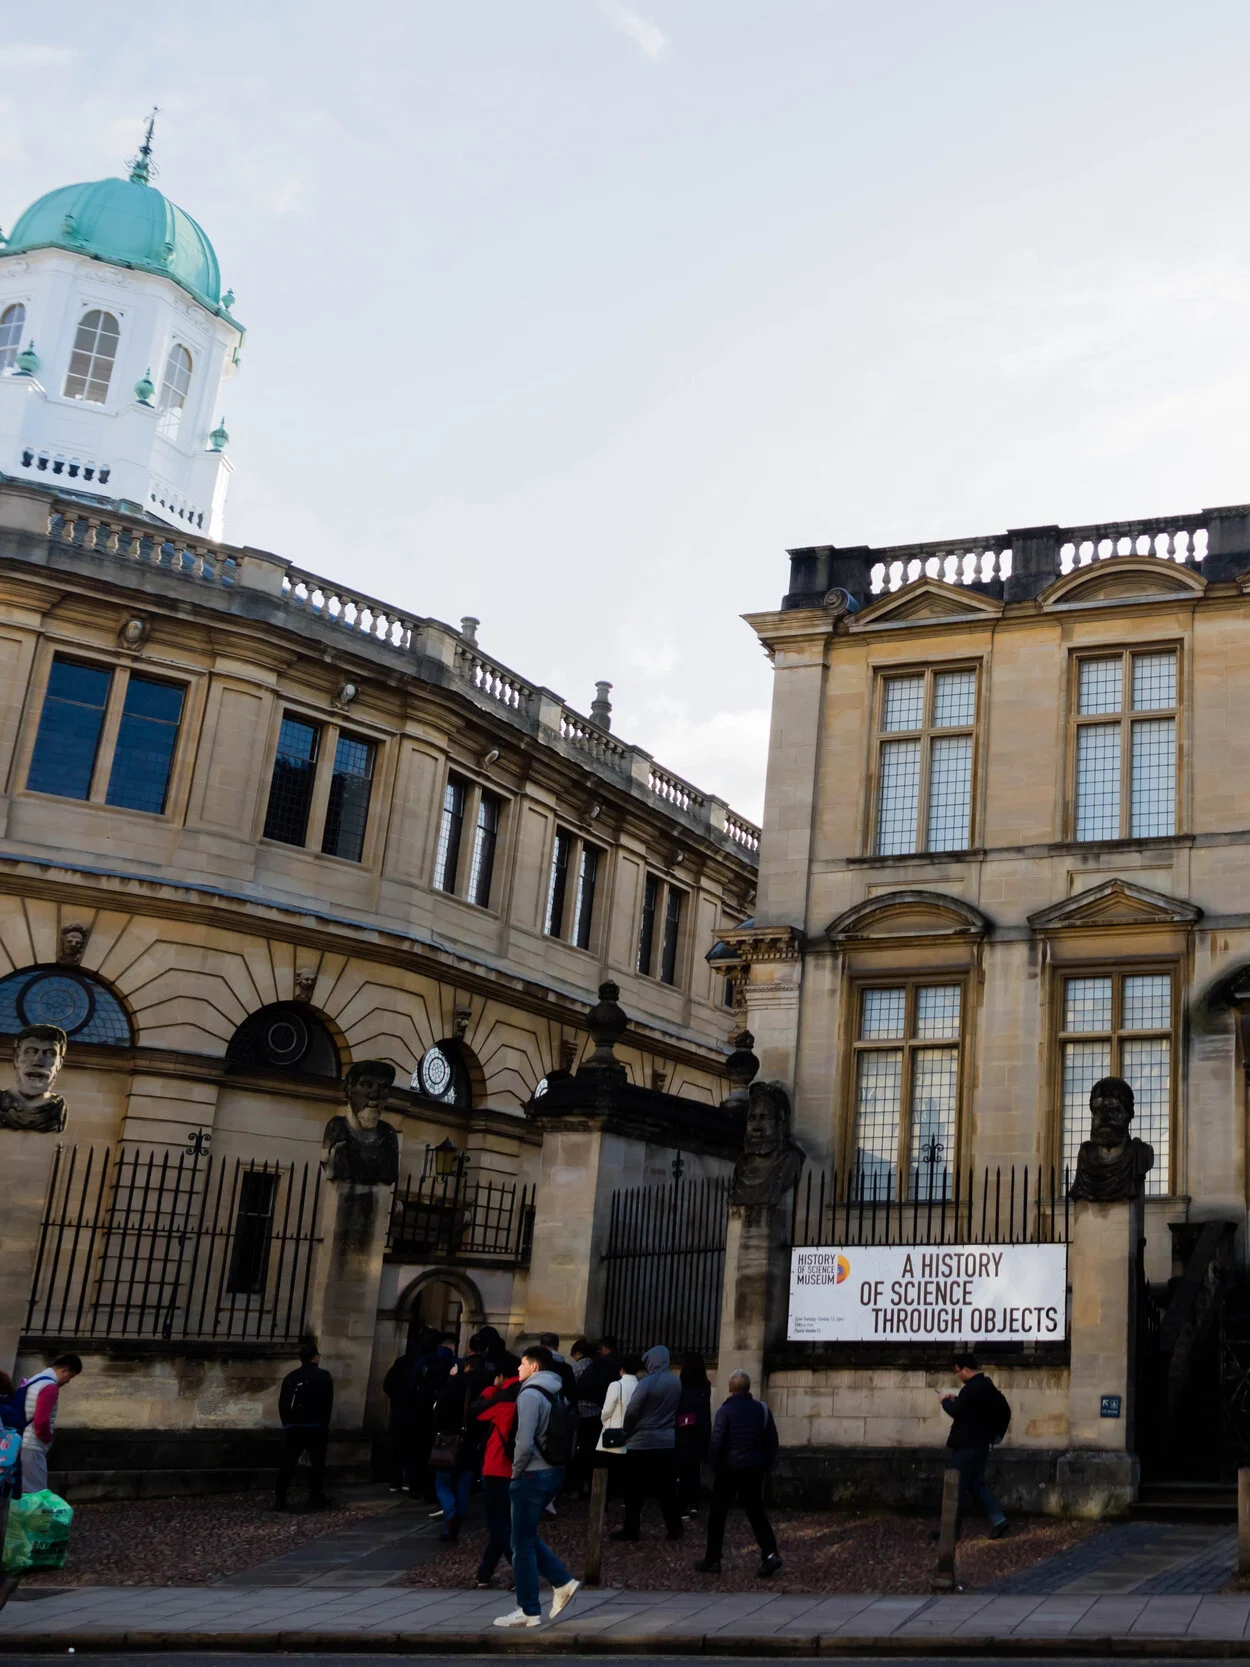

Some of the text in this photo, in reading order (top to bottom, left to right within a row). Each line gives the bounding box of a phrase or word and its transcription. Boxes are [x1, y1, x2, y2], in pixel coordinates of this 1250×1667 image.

[797, 1254, 836, 1265] HISTORY
[901, 1252, 1004, 1278] A HISTORY
[797, 1265, 835, 1274] OF SCIENCE
[797, 1274, 835, 1285] MUSEUM
[860, 1280, 973, 1306] OF SCIENCE
[872, 1306, 1058, 1333] THROUGH OBJECTS
